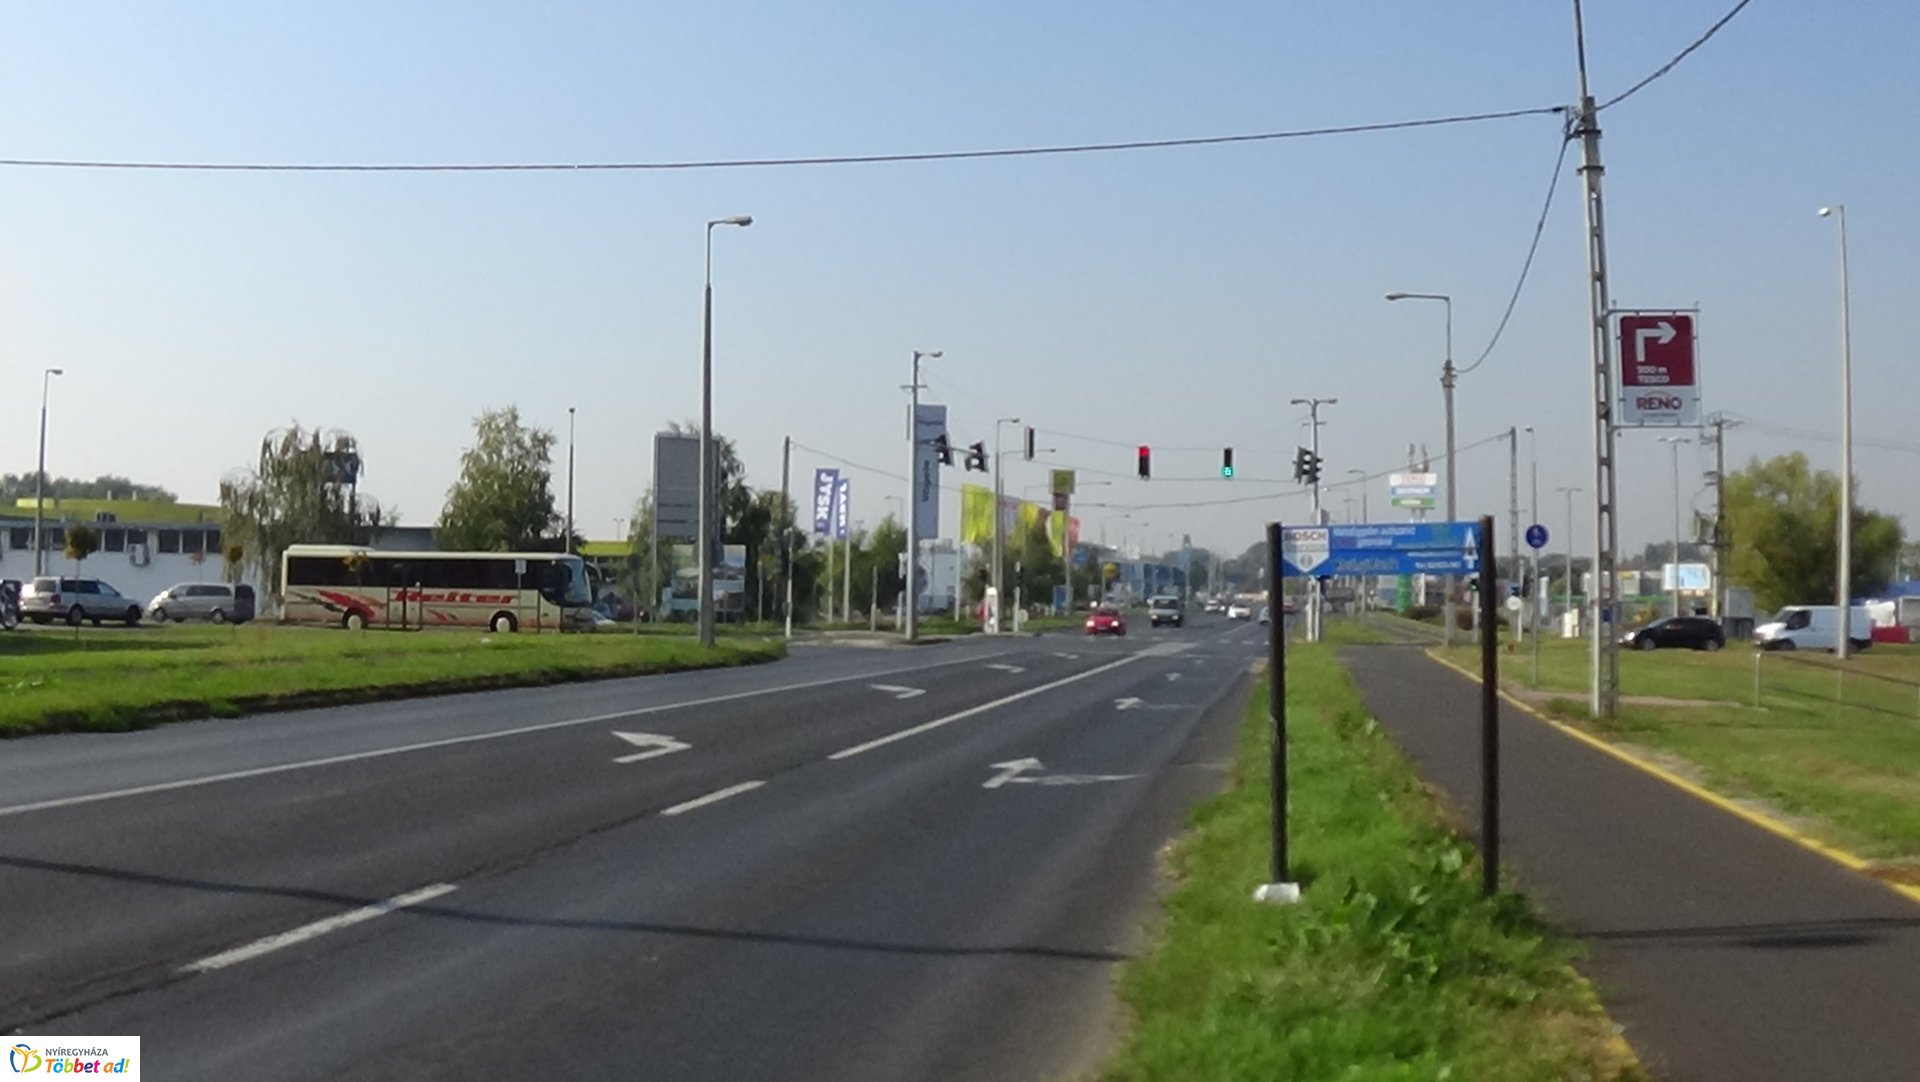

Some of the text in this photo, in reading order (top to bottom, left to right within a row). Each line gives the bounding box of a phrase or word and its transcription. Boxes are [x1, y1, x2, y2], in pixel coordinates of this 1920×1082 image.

[1637, 375, 1670, 383] TESCO
[1636, 396, 1683, 410] RENO
[816, 472, 834, 520] JYSK
[1284, 530, 1327, 542] BOSCH
